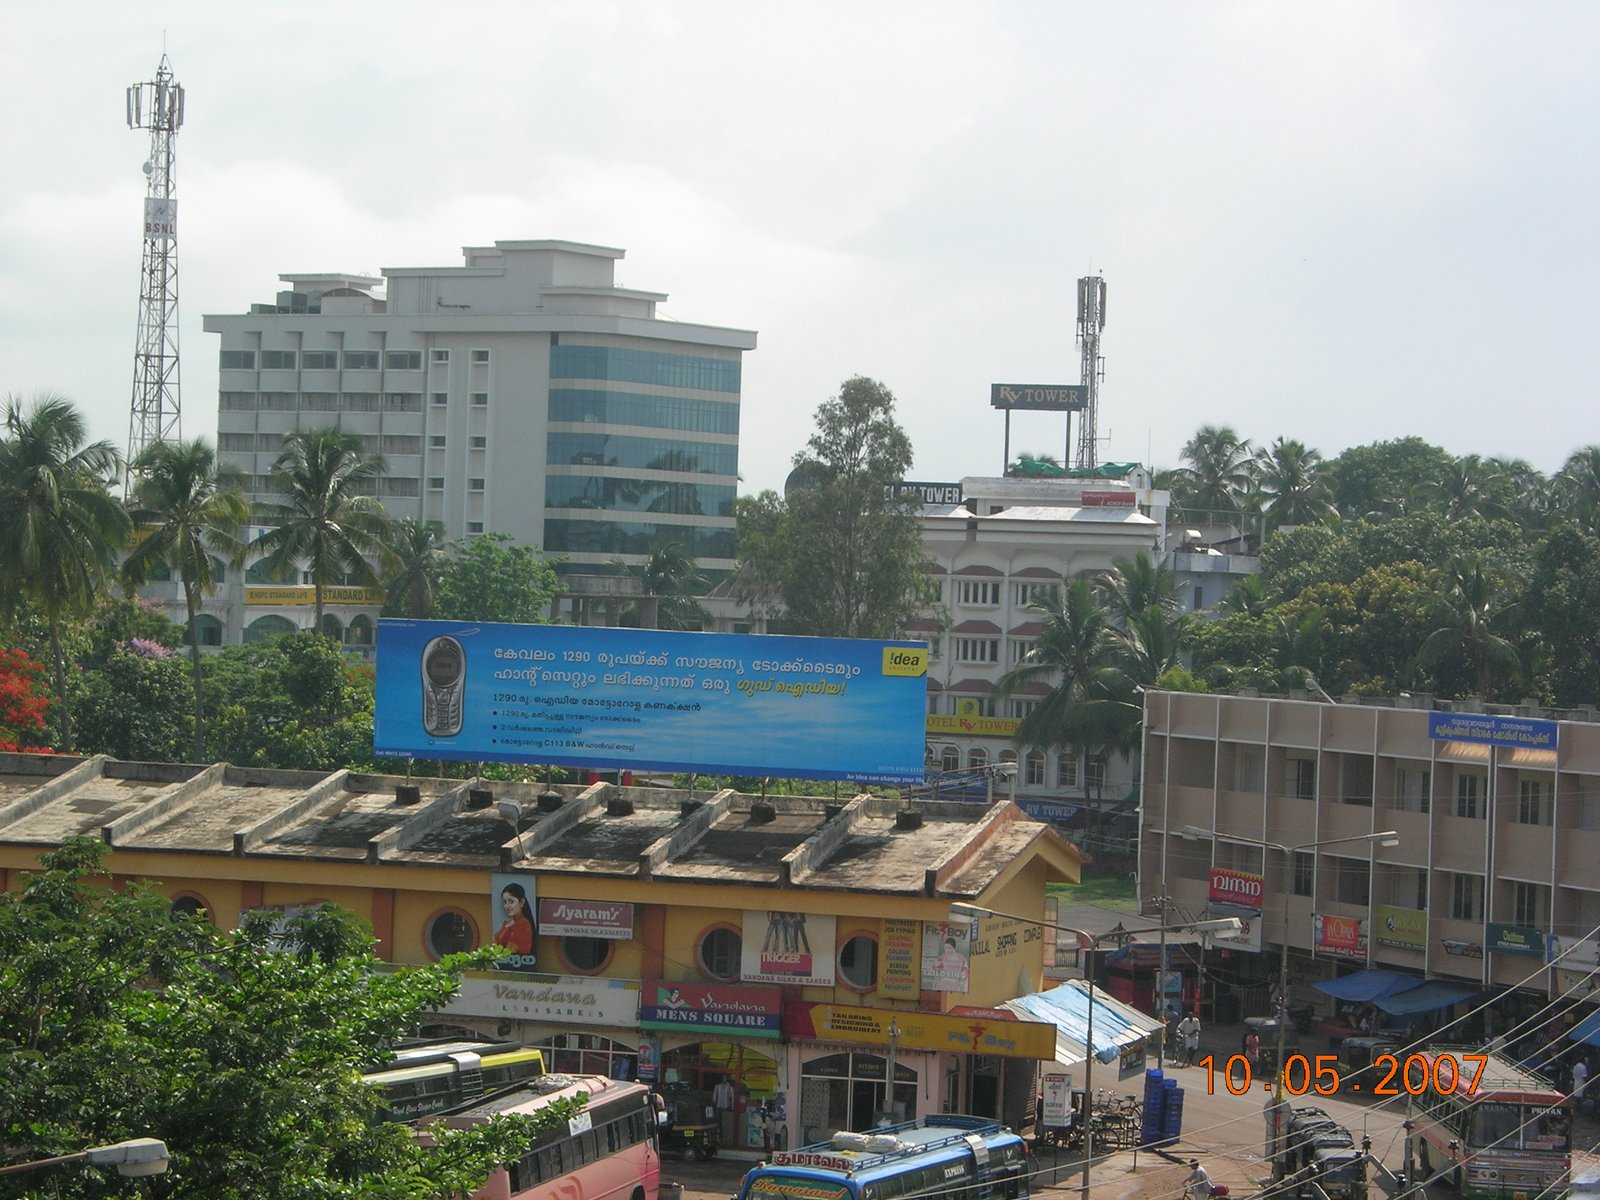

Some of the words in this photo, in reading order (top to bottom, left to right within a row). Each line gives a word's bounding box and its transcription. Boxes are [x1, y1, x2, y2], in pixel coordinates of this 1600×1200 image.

[146, 223, 174, 234] BSNL
[1024, 388, 1079, 403] TOWER
[920, 486, 959, 502] TOWER
[322, 590, 364, 600] STANDARD
[494, 648, 556, 662] കേവലം
[562, 650, 591, 662] 1290
[702, 680, 730, 695] ഒരു
[492, 693, 516, 702] 1290
[926, 717, 955, 728] OTEL
[1213, 875, 1260, 896] വന്ദന
[552, 904, 620, 920] Ayaram's
[925, 926, 940, 936] Fit
[948, 927, 968, 940] Boy
[760, 952, 800, 964] TRIGGER
[494, 984, 596, 1006] Vandana
[700, 993, 766, 1012] Vandana
[656, 1008, 698, 1022] MENS
[703, 1012, 766, 1026] SQUARE
[831, 1018, 874, 1027] DESIGNING
[832, 1013, 872, 1021] TAILORING
